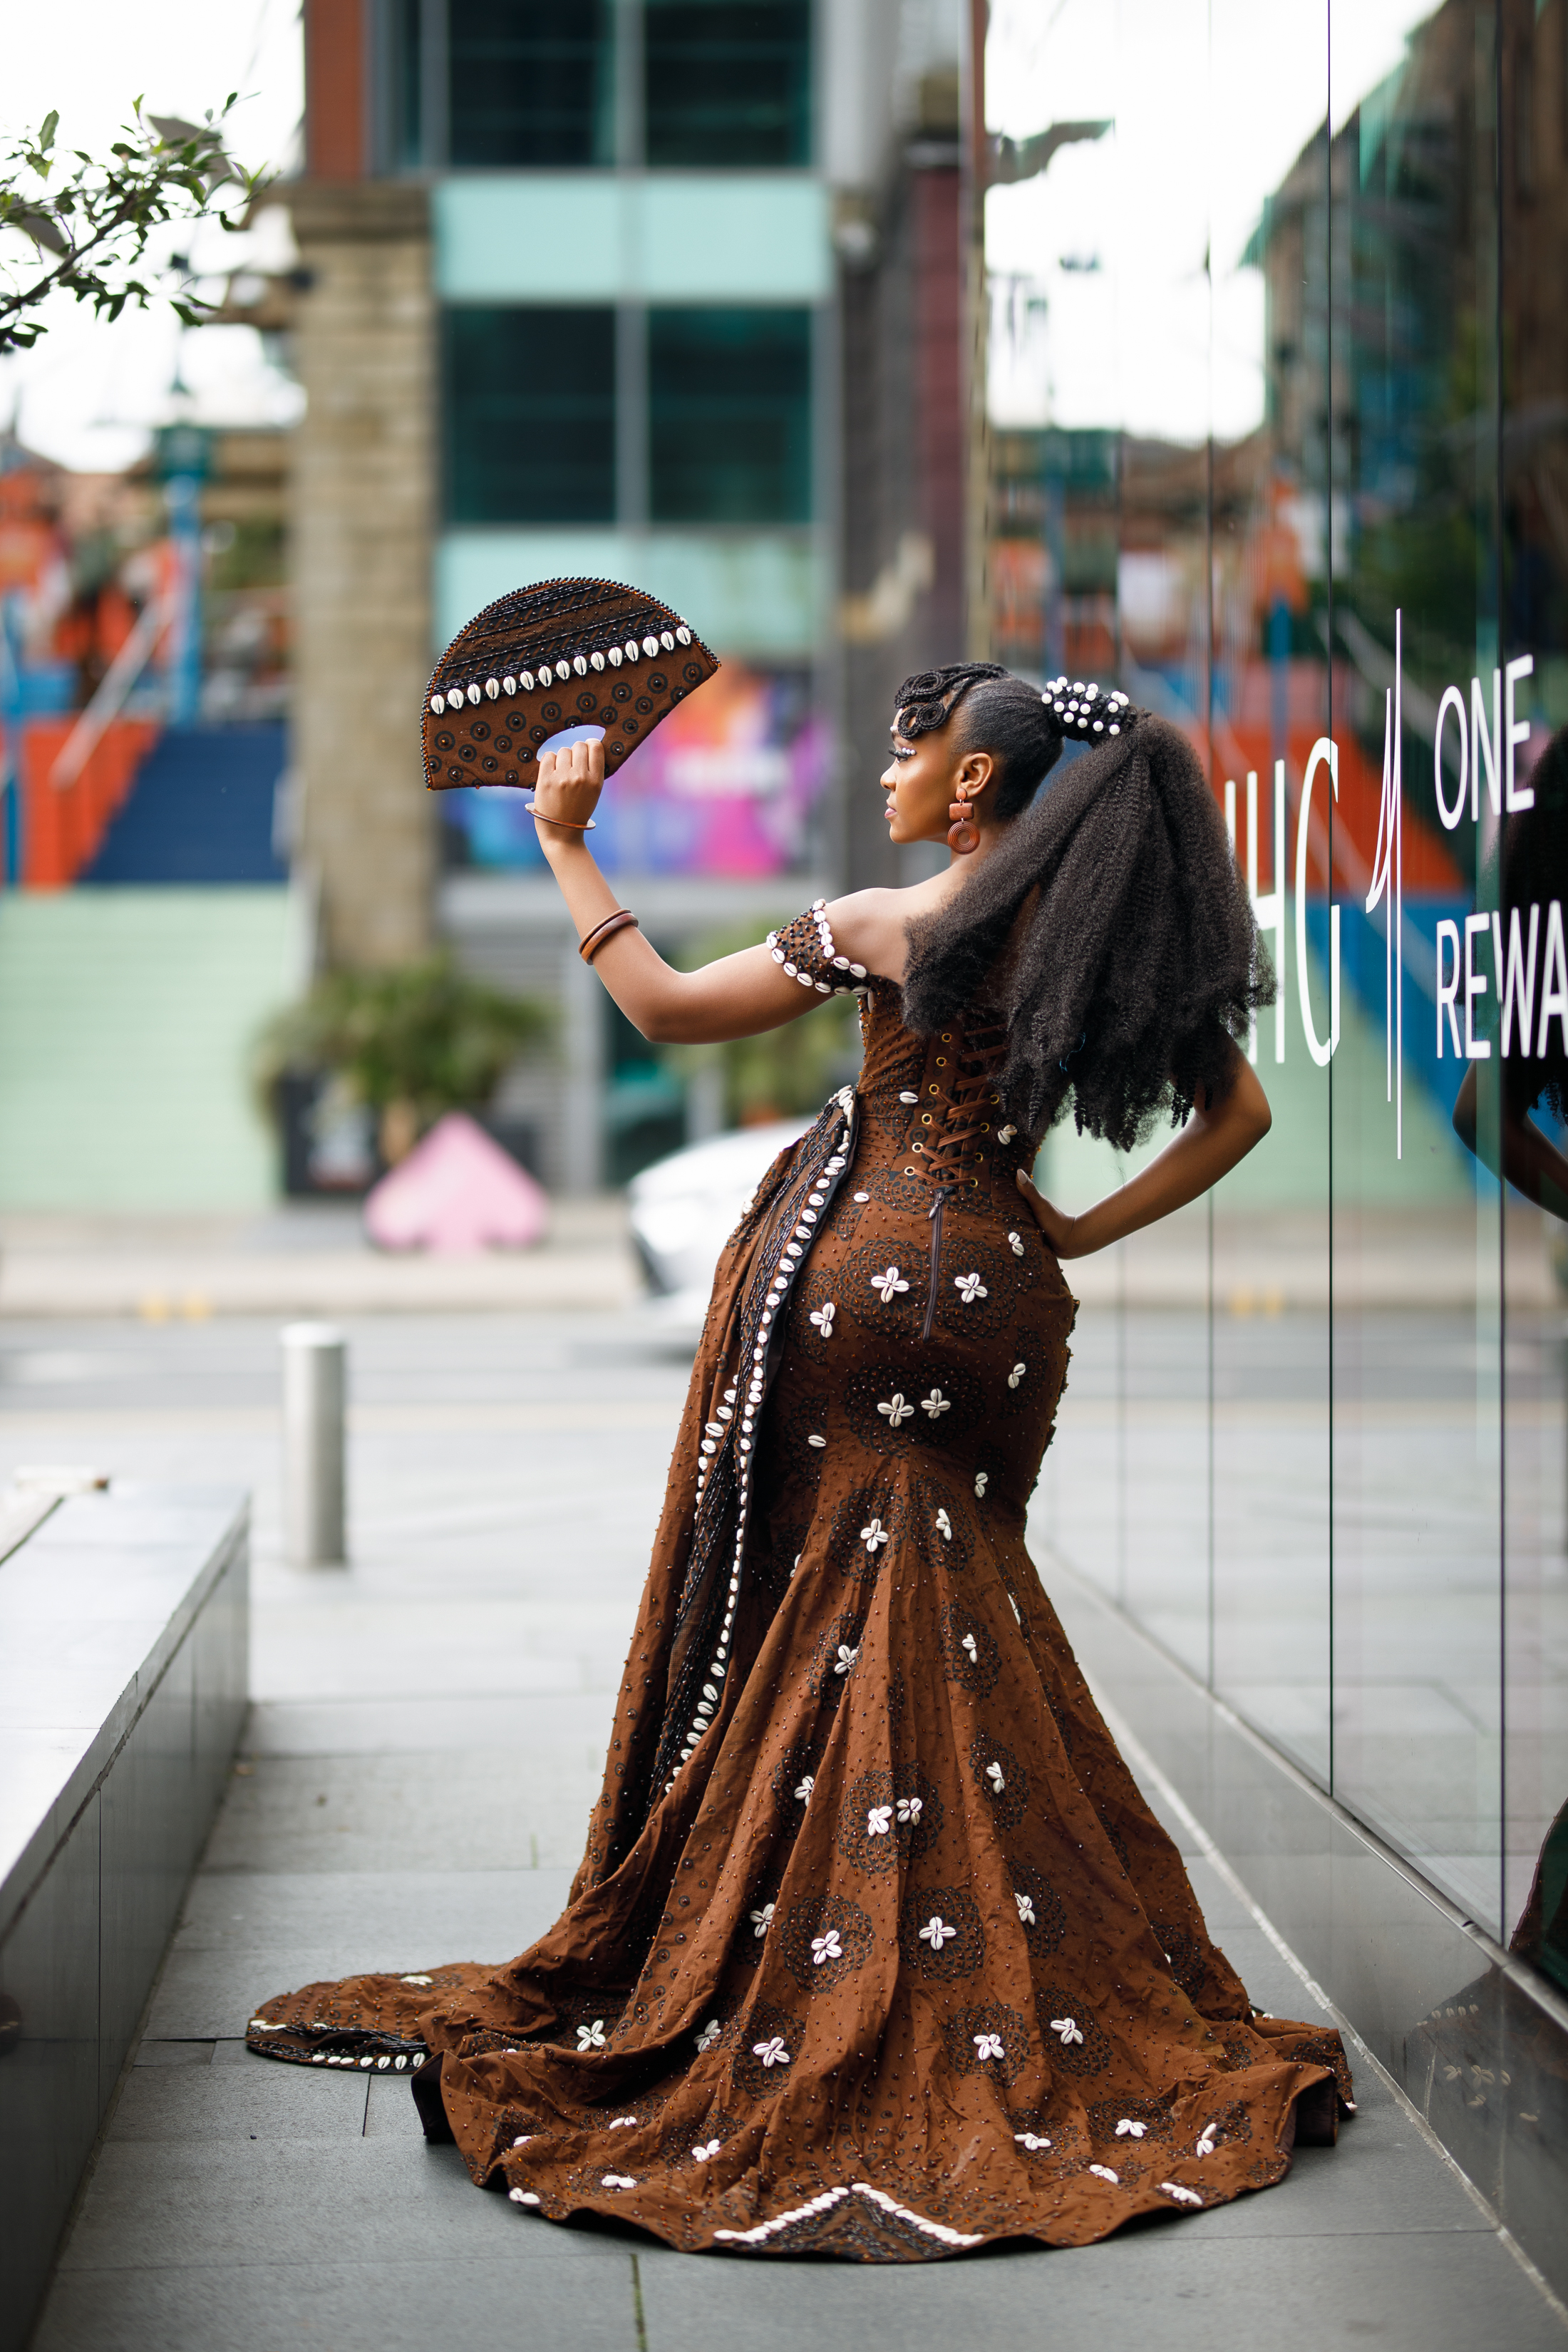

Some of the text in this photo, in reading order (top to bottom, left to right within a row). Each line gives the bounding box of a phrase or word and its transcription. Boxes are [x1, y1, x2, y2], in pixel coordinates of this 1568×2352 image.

[1434, 654, 1535, 830] ONE
[1224, 736, 1341, 1067] HG
[1436, 899, 1568, 1059] REWA
